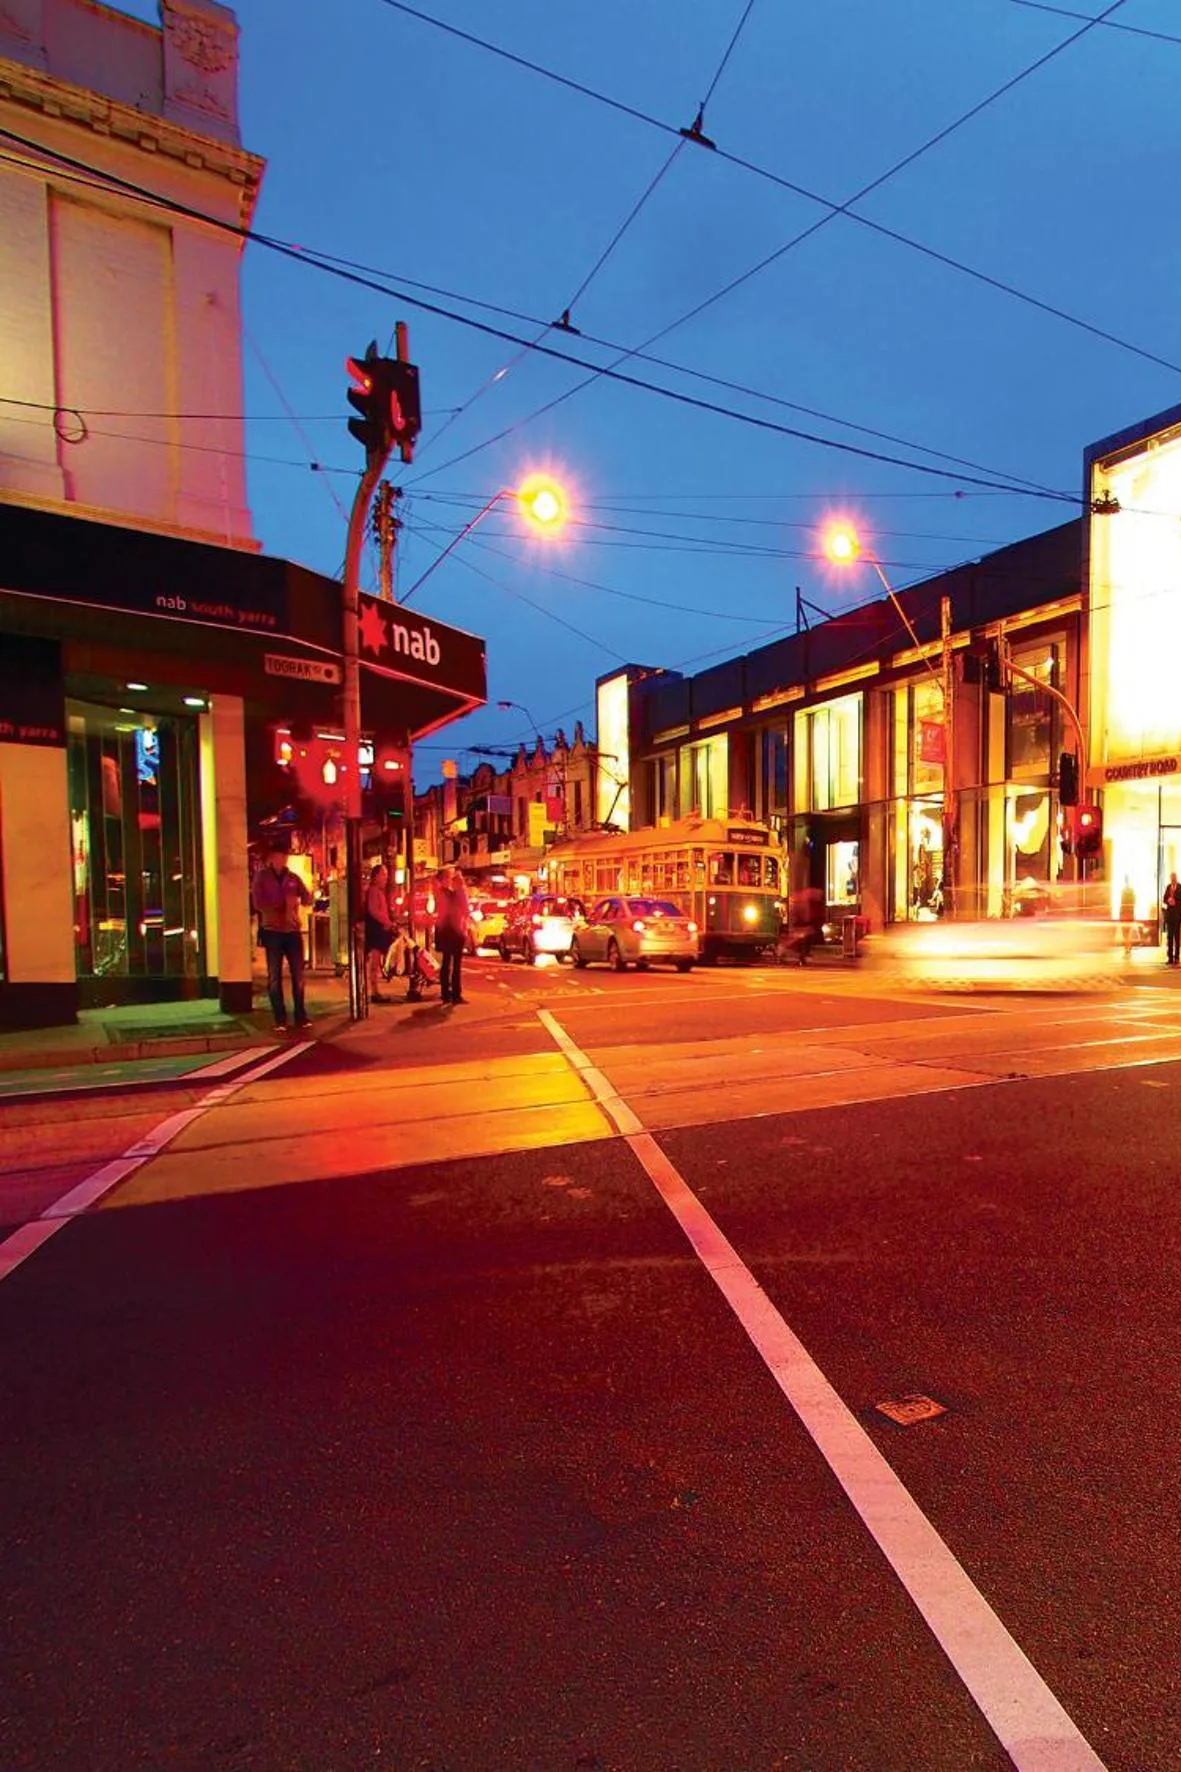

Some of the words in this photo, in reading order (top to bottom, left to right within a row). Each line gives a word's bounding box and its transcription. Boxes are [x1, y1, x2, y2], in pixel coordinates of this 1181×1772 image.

[156, 595, 187, 611] nab
[238, 610, 277, 627] yarra
[392, 623, 440, 666] nab
[1105, 763, 1149, 781] COUNTRY
